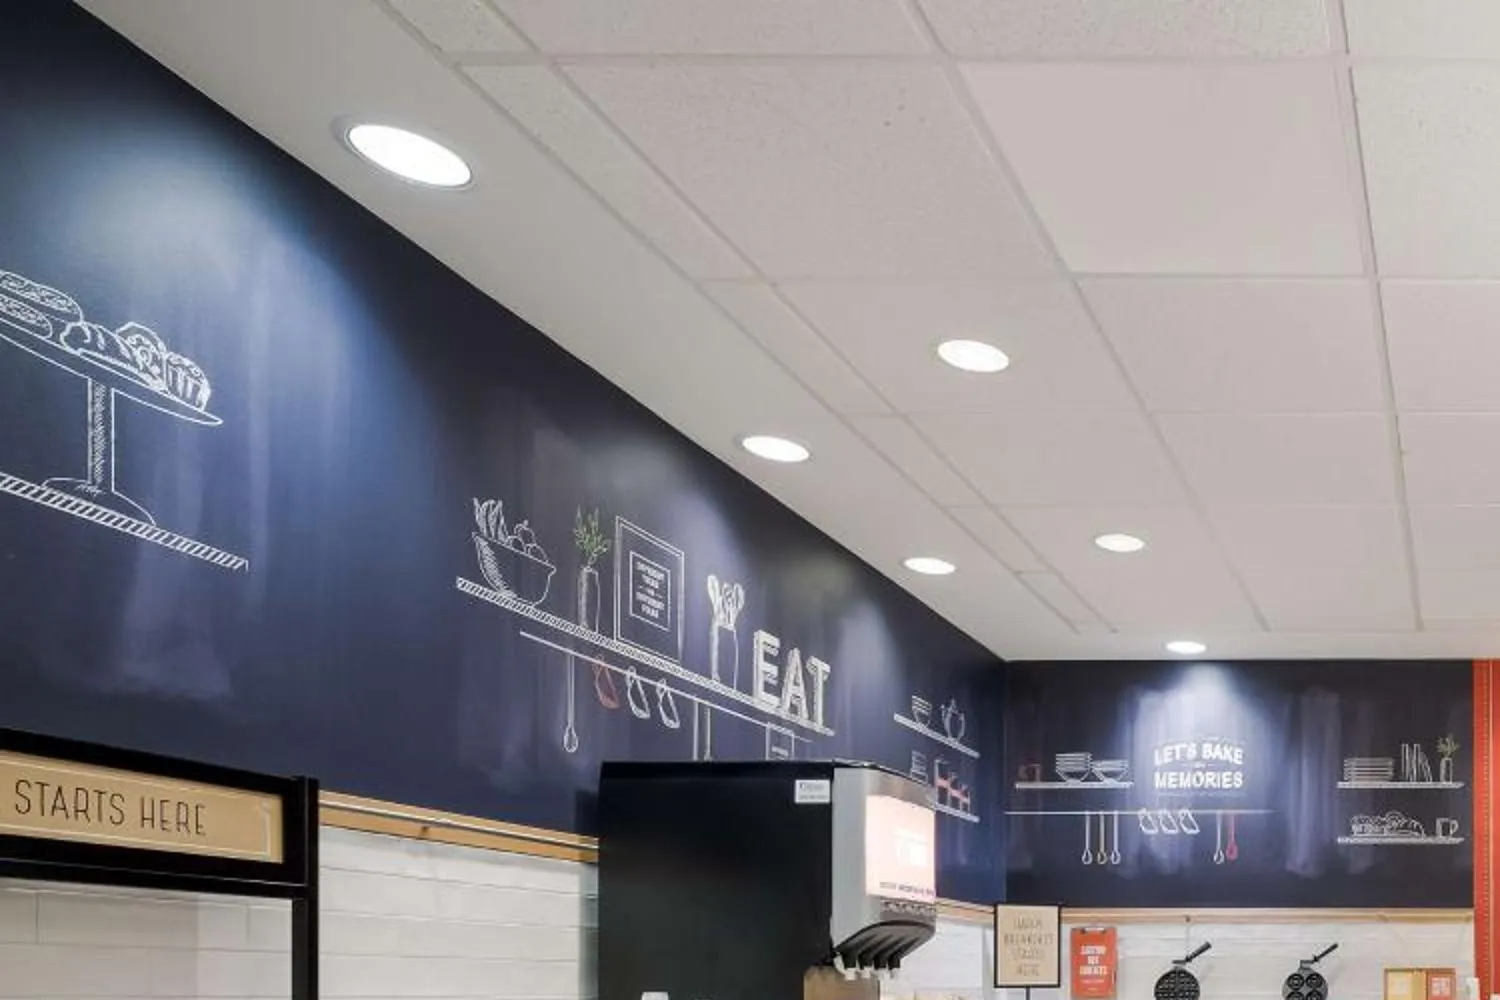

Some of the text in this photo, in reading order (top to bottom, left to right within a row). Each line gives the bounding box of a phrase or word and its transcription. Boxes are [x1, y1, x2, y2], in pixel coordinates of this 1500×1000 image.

[753, 629, 831, 727] EAT
[1154, 743, 1243, 766] LET'S BAKE
[1154, 771, 1243, 789] MEMORIES
[15, 779, 207, 836] STARTS HERE
